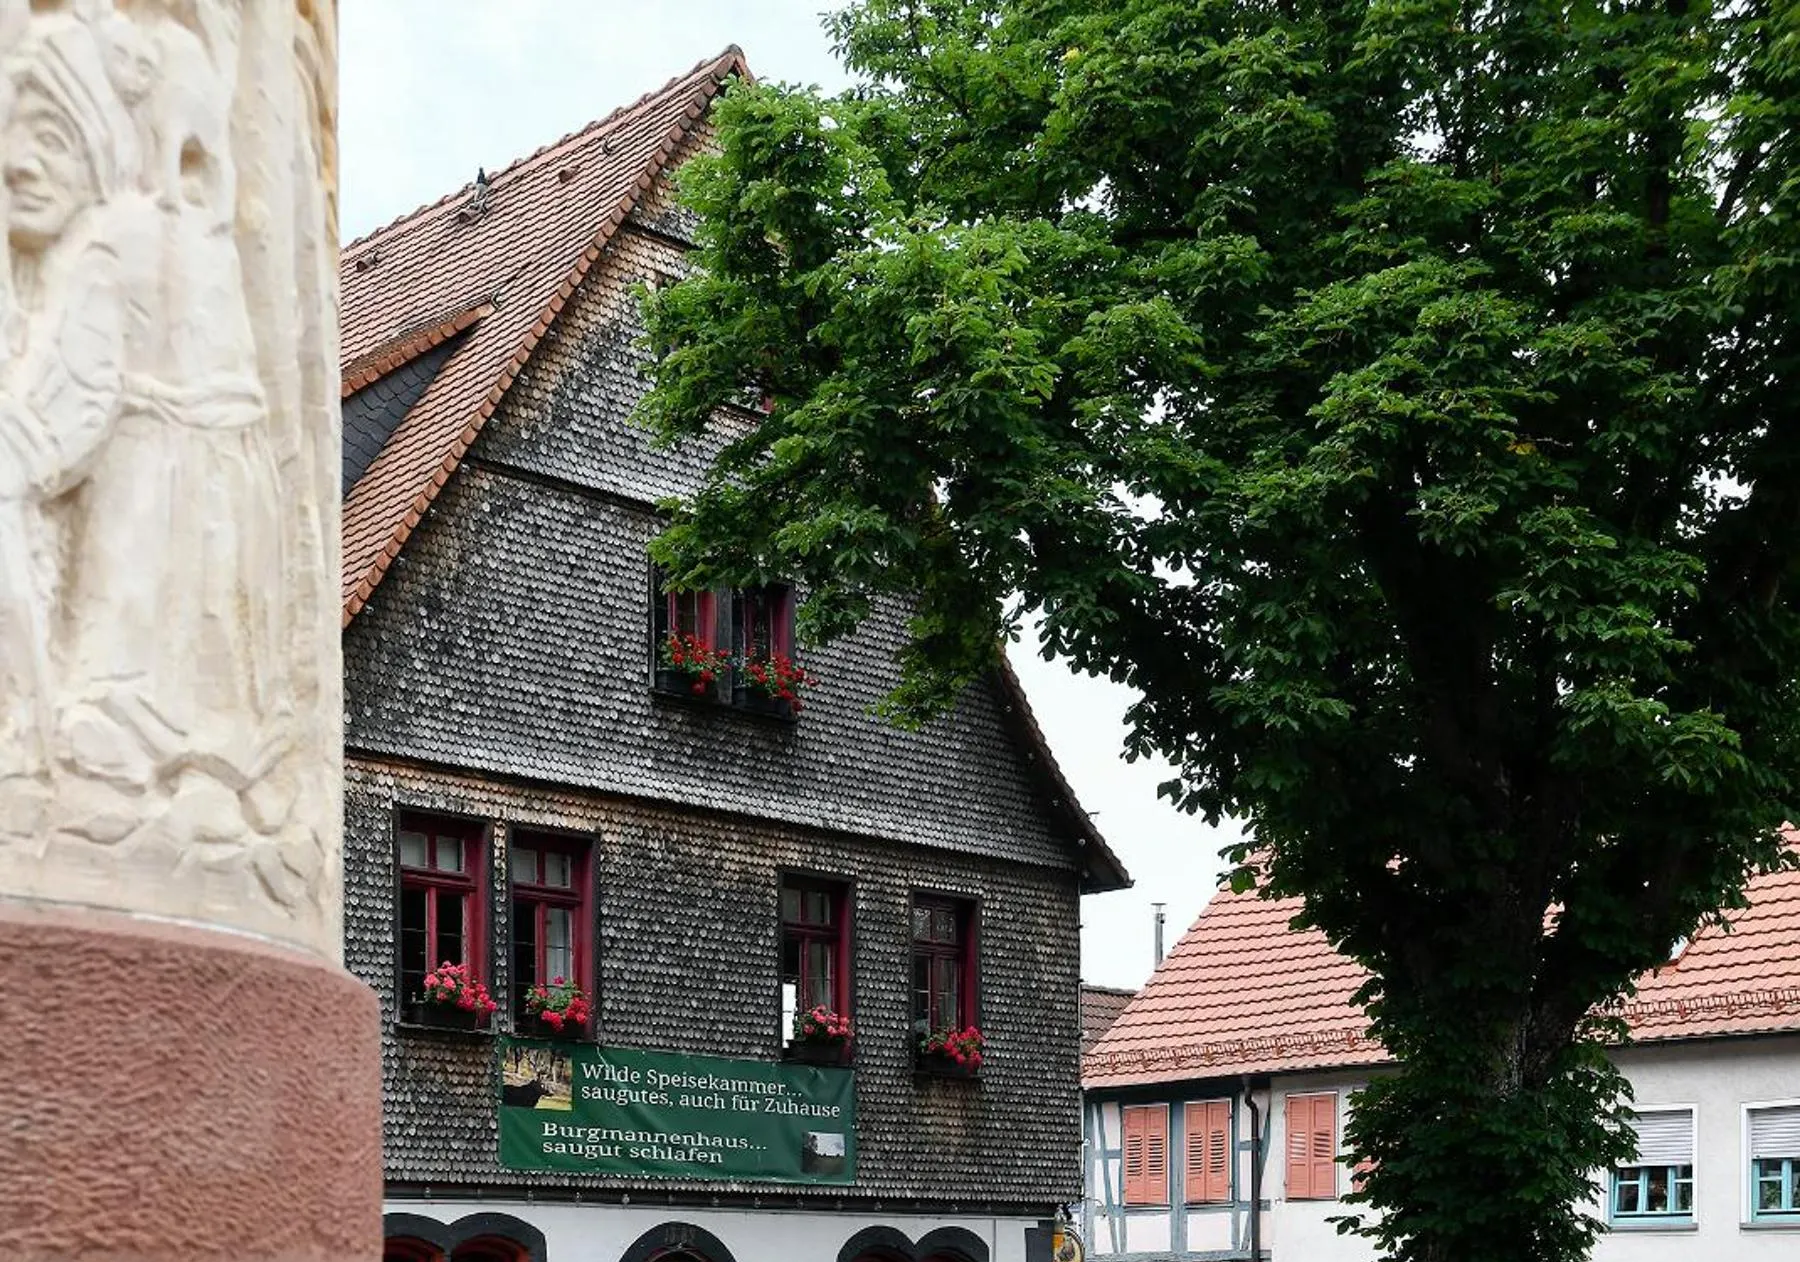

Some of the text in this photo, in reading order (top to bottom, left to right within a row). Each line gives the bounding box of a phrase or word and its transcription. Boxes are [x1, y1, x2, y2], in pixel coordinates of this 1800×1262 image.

[581, 1062, 802, 1097] Wilde Speisekammer...
[581, 1085, 841, 1118] saugutes, auch für Zuhause
[542, 1121, 767, 1150] Burgmannenhaus...
[543, 1141, 723, 1163] saugut schlafen
